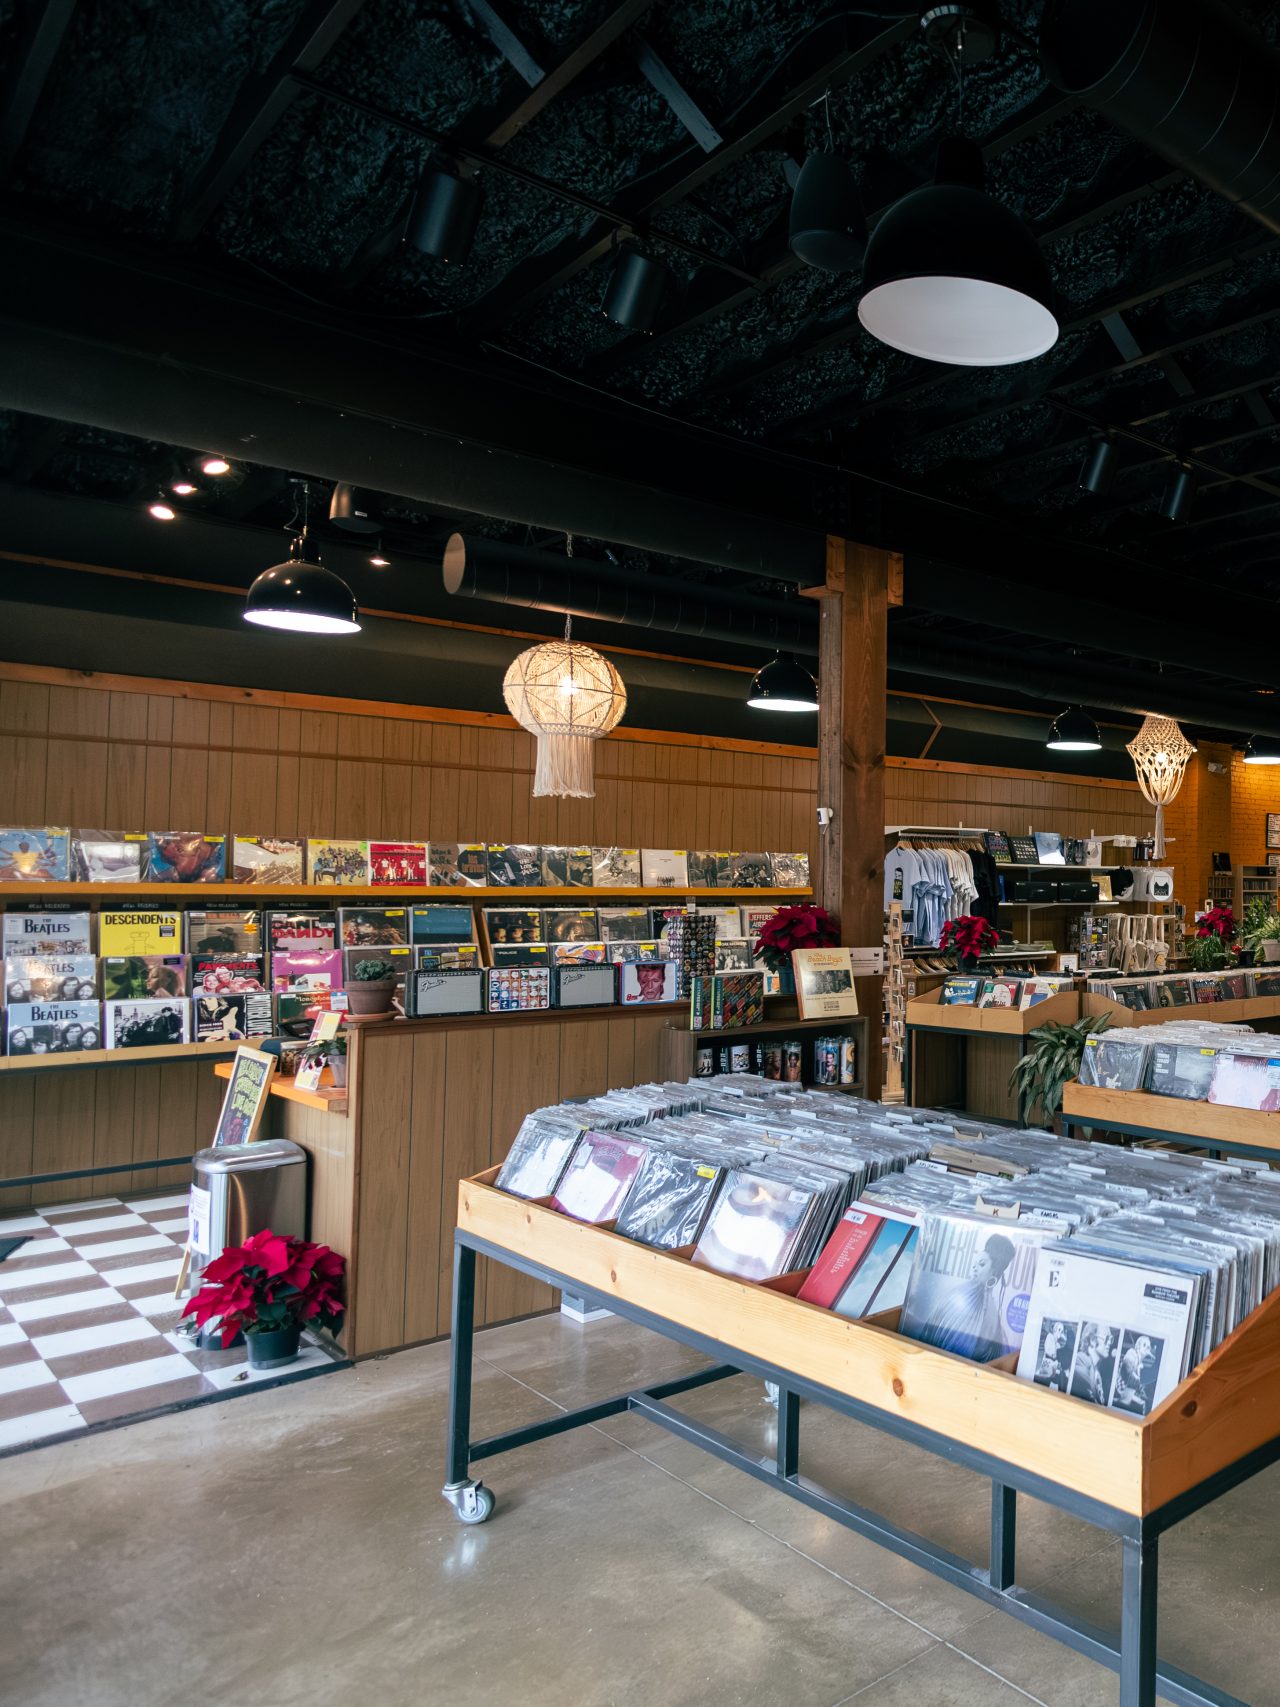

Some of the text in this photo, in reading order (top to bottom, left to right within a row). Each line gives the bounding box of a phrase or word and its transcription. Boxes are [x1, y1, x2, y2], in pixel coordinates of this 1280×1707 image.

[24, 919, 71, 935] BEATLES
[105, 914, 177, 926] DESCENDENTS
[31, 1006, 78, 1021] BEATLES
[992, 1208, 1000, 1217] K
[1049, 1271, 1060, 1287] E
